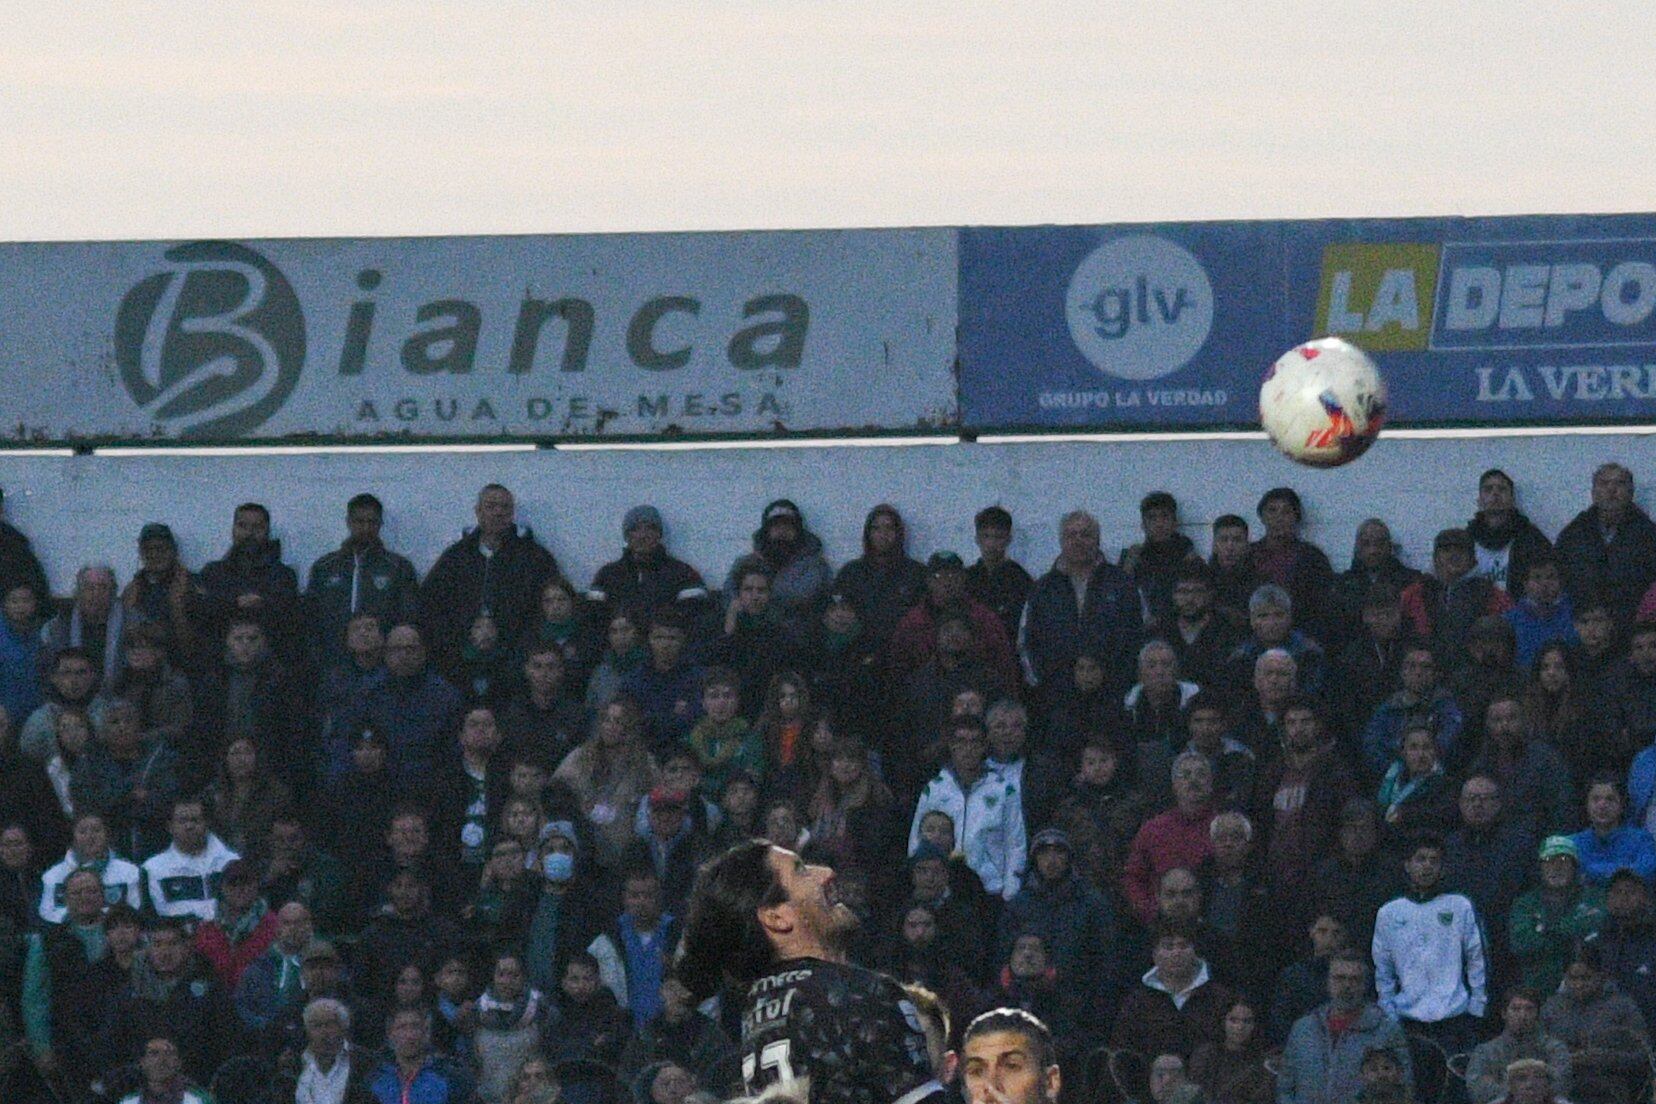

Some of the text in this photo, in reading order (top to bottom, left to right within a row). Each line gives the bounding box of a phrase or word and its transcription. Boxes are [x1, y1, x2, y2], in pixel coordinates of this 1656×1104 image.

[1093, 273, 1190, 341] glv
[1326, 268, 1420, 333] LA
[1039, 389, 1228, 409] GRUPO LA VERDAD
[1475, 366, 1535, 401] LA
[356, 394, 784, 422] AGUA DE MESA
